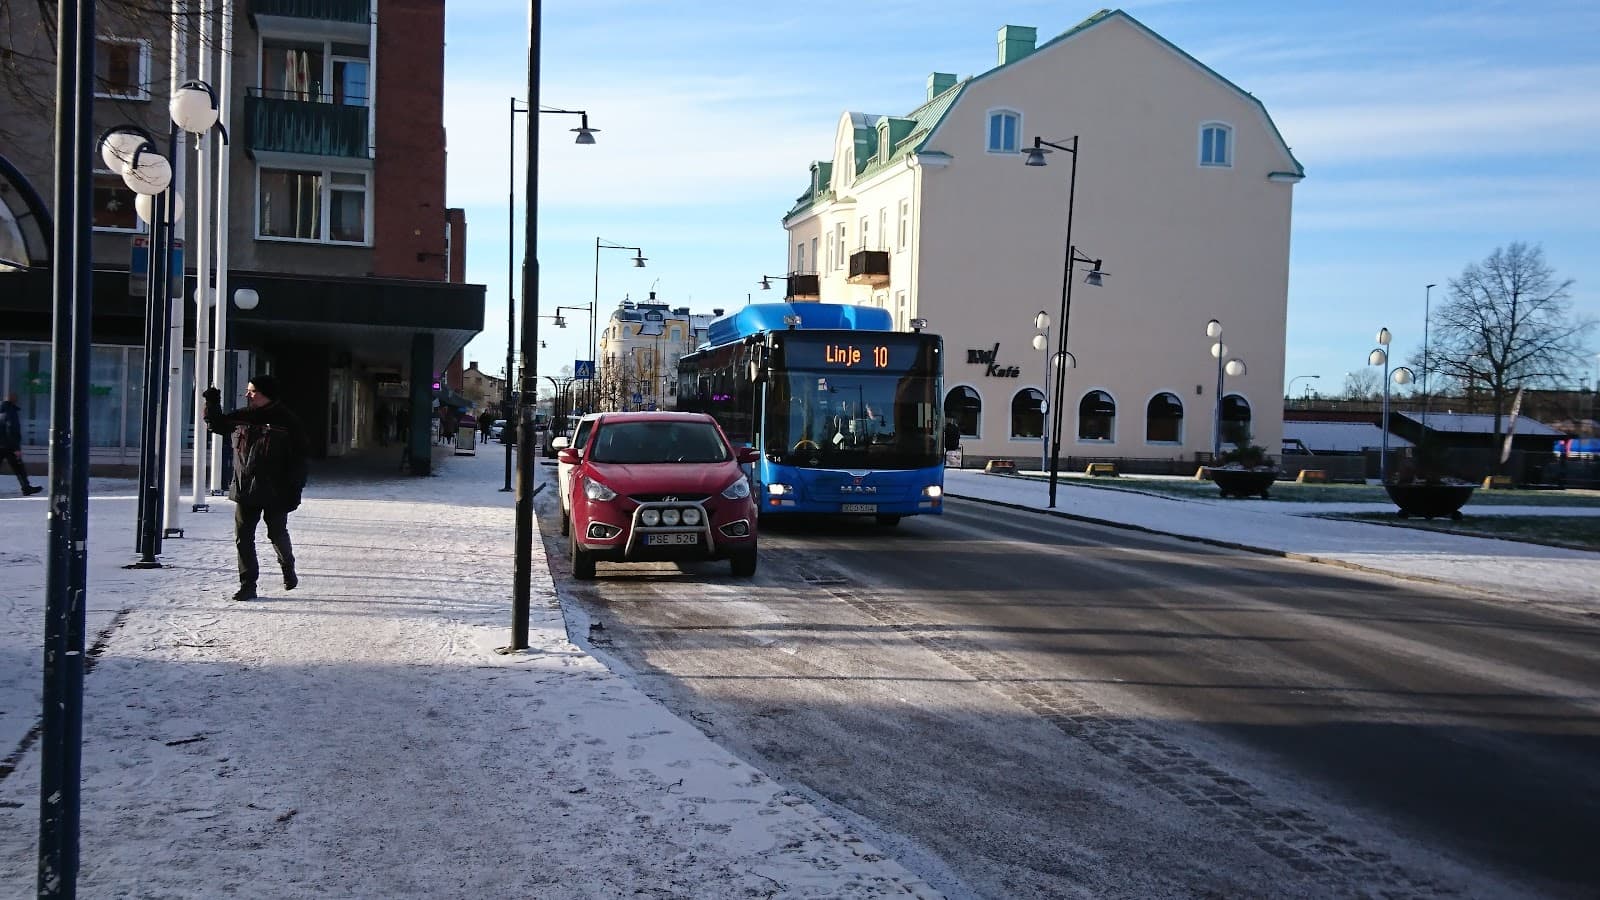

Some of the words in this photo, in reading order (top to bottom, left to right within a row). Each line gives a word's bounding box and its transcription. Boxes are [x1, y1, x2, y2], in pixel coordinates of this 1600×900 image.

[826, 345, 861, 367] Linje
[873, 346, 888, 368] 10
[840, 486, 877, 494] MAN
[649, 534, 669, 544] PSE
[676, 534, 696, 543] 526
